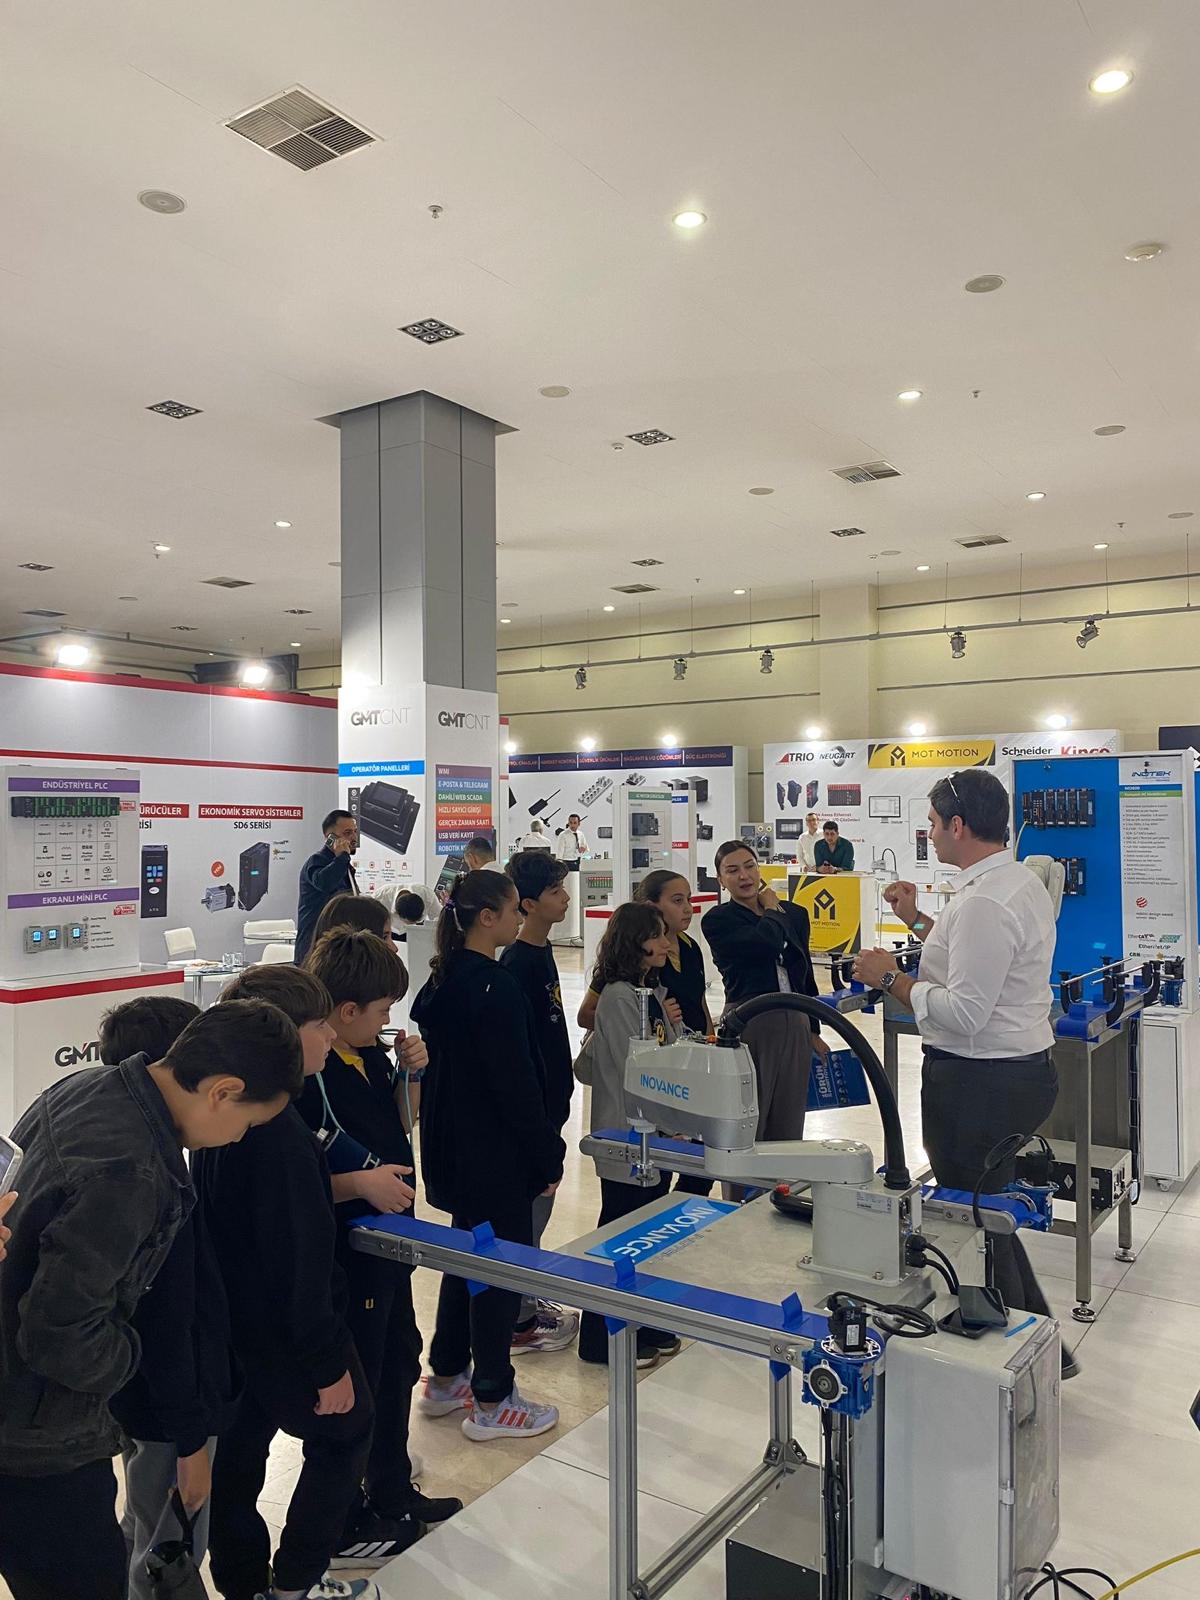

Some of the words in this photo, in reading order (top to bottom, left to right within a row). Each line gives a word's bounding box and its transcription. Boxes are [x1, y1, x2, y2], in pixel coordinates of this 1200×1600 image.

[819, 751, 856, 760] NEUGART
[911, 750, 935, 758] MOT
[936, 748, 979, 757] MOTION
[1002, 745, 1053, 756] Schneider
[789, 752, 815, 762] TRIO
[351, 764, 381, 774] OPERATÖR
[380, 763, 410, 772] PANELLERİ
[42, 780, 93, 790] ENDÜSTRİYEL
[94, 782, 109, 790] PLC
[140, 804, 182, 816] ÜRÜCÜLER
[200, 803, 241, 816] EKONOMİK
[241, 808, 265, 817] SERVO
[265, 806, 302, 818] SİSTEMLER
[140, 820, 152, 830] İSİ
[233, 821, 249, 830] SD6
[249, 820, 272, 830] SERİSİ
[42, 895, 75, 905] EKRANLI
[76, 892, 94, 903] MİNİ
[94, 893, 108, 901] PLC
[640, 1073, 690, 1101] INOVANCE
[612, 1206, 718, 1258] INOVANCE
